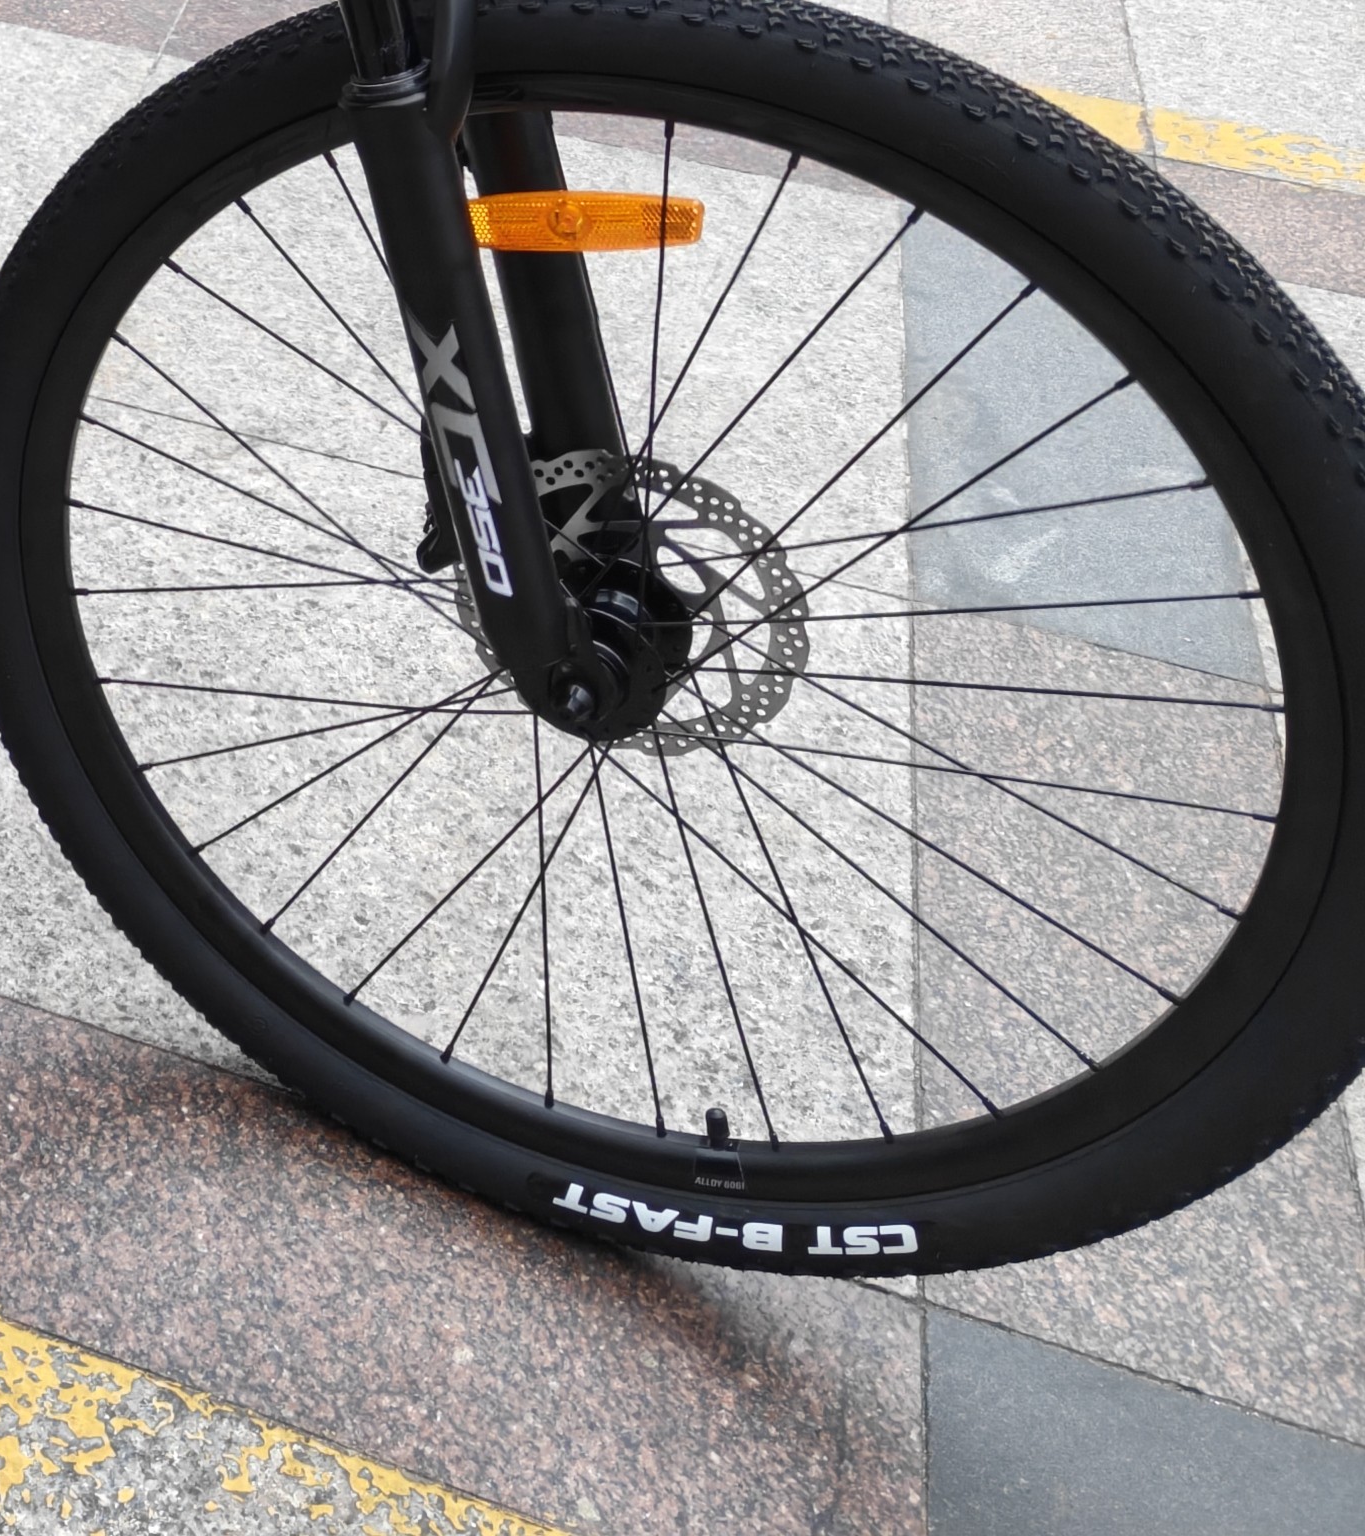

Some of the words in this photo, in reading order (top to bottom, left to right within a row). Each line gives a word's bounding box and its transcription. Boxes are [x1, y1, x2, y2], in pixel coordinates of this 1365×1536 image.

[454, 458, 513, 597] 350
[694, 1176, 723, 1189] ALLOY
[552, 1183, 783, 1253] B-FAST
[807, 1224, 919, 1256] CST
